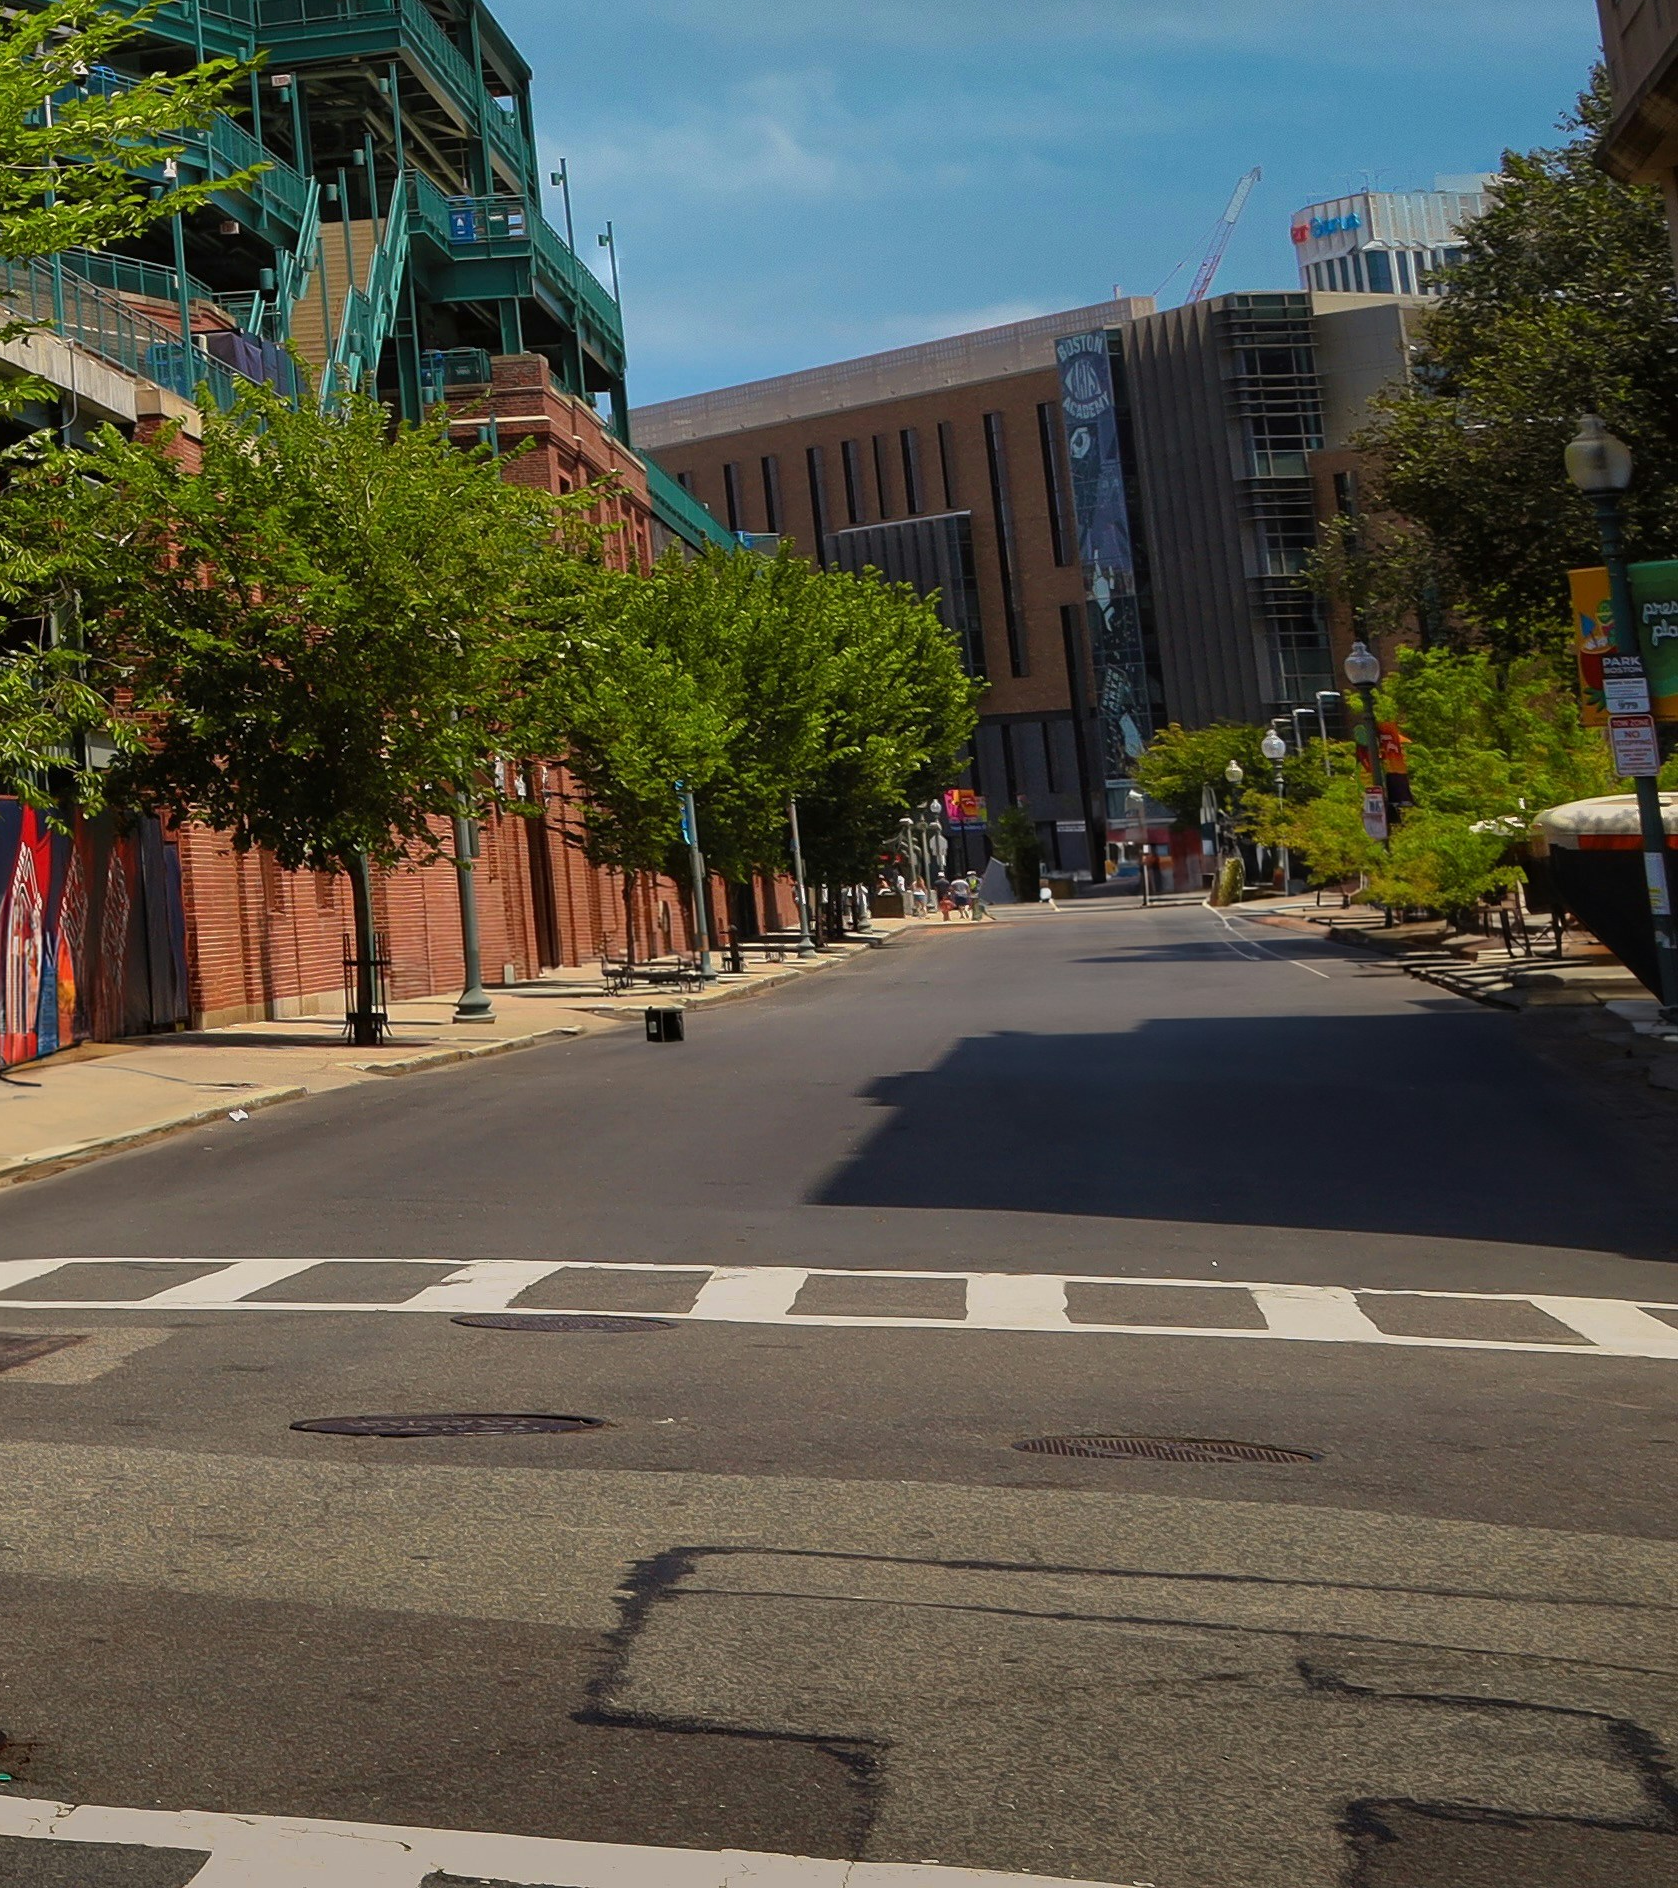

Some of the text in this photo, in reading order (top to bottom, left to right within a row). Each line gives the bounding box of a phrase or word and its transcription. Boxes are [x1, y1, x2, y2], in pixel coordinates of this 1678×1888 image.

[1057, 334, 1104, 362] BOSTON
[1062, 391, 1110, 419] ACADEMY
[1602, 656, 1642, 667] PARK
[1625, 730, 1640, 739] NO
